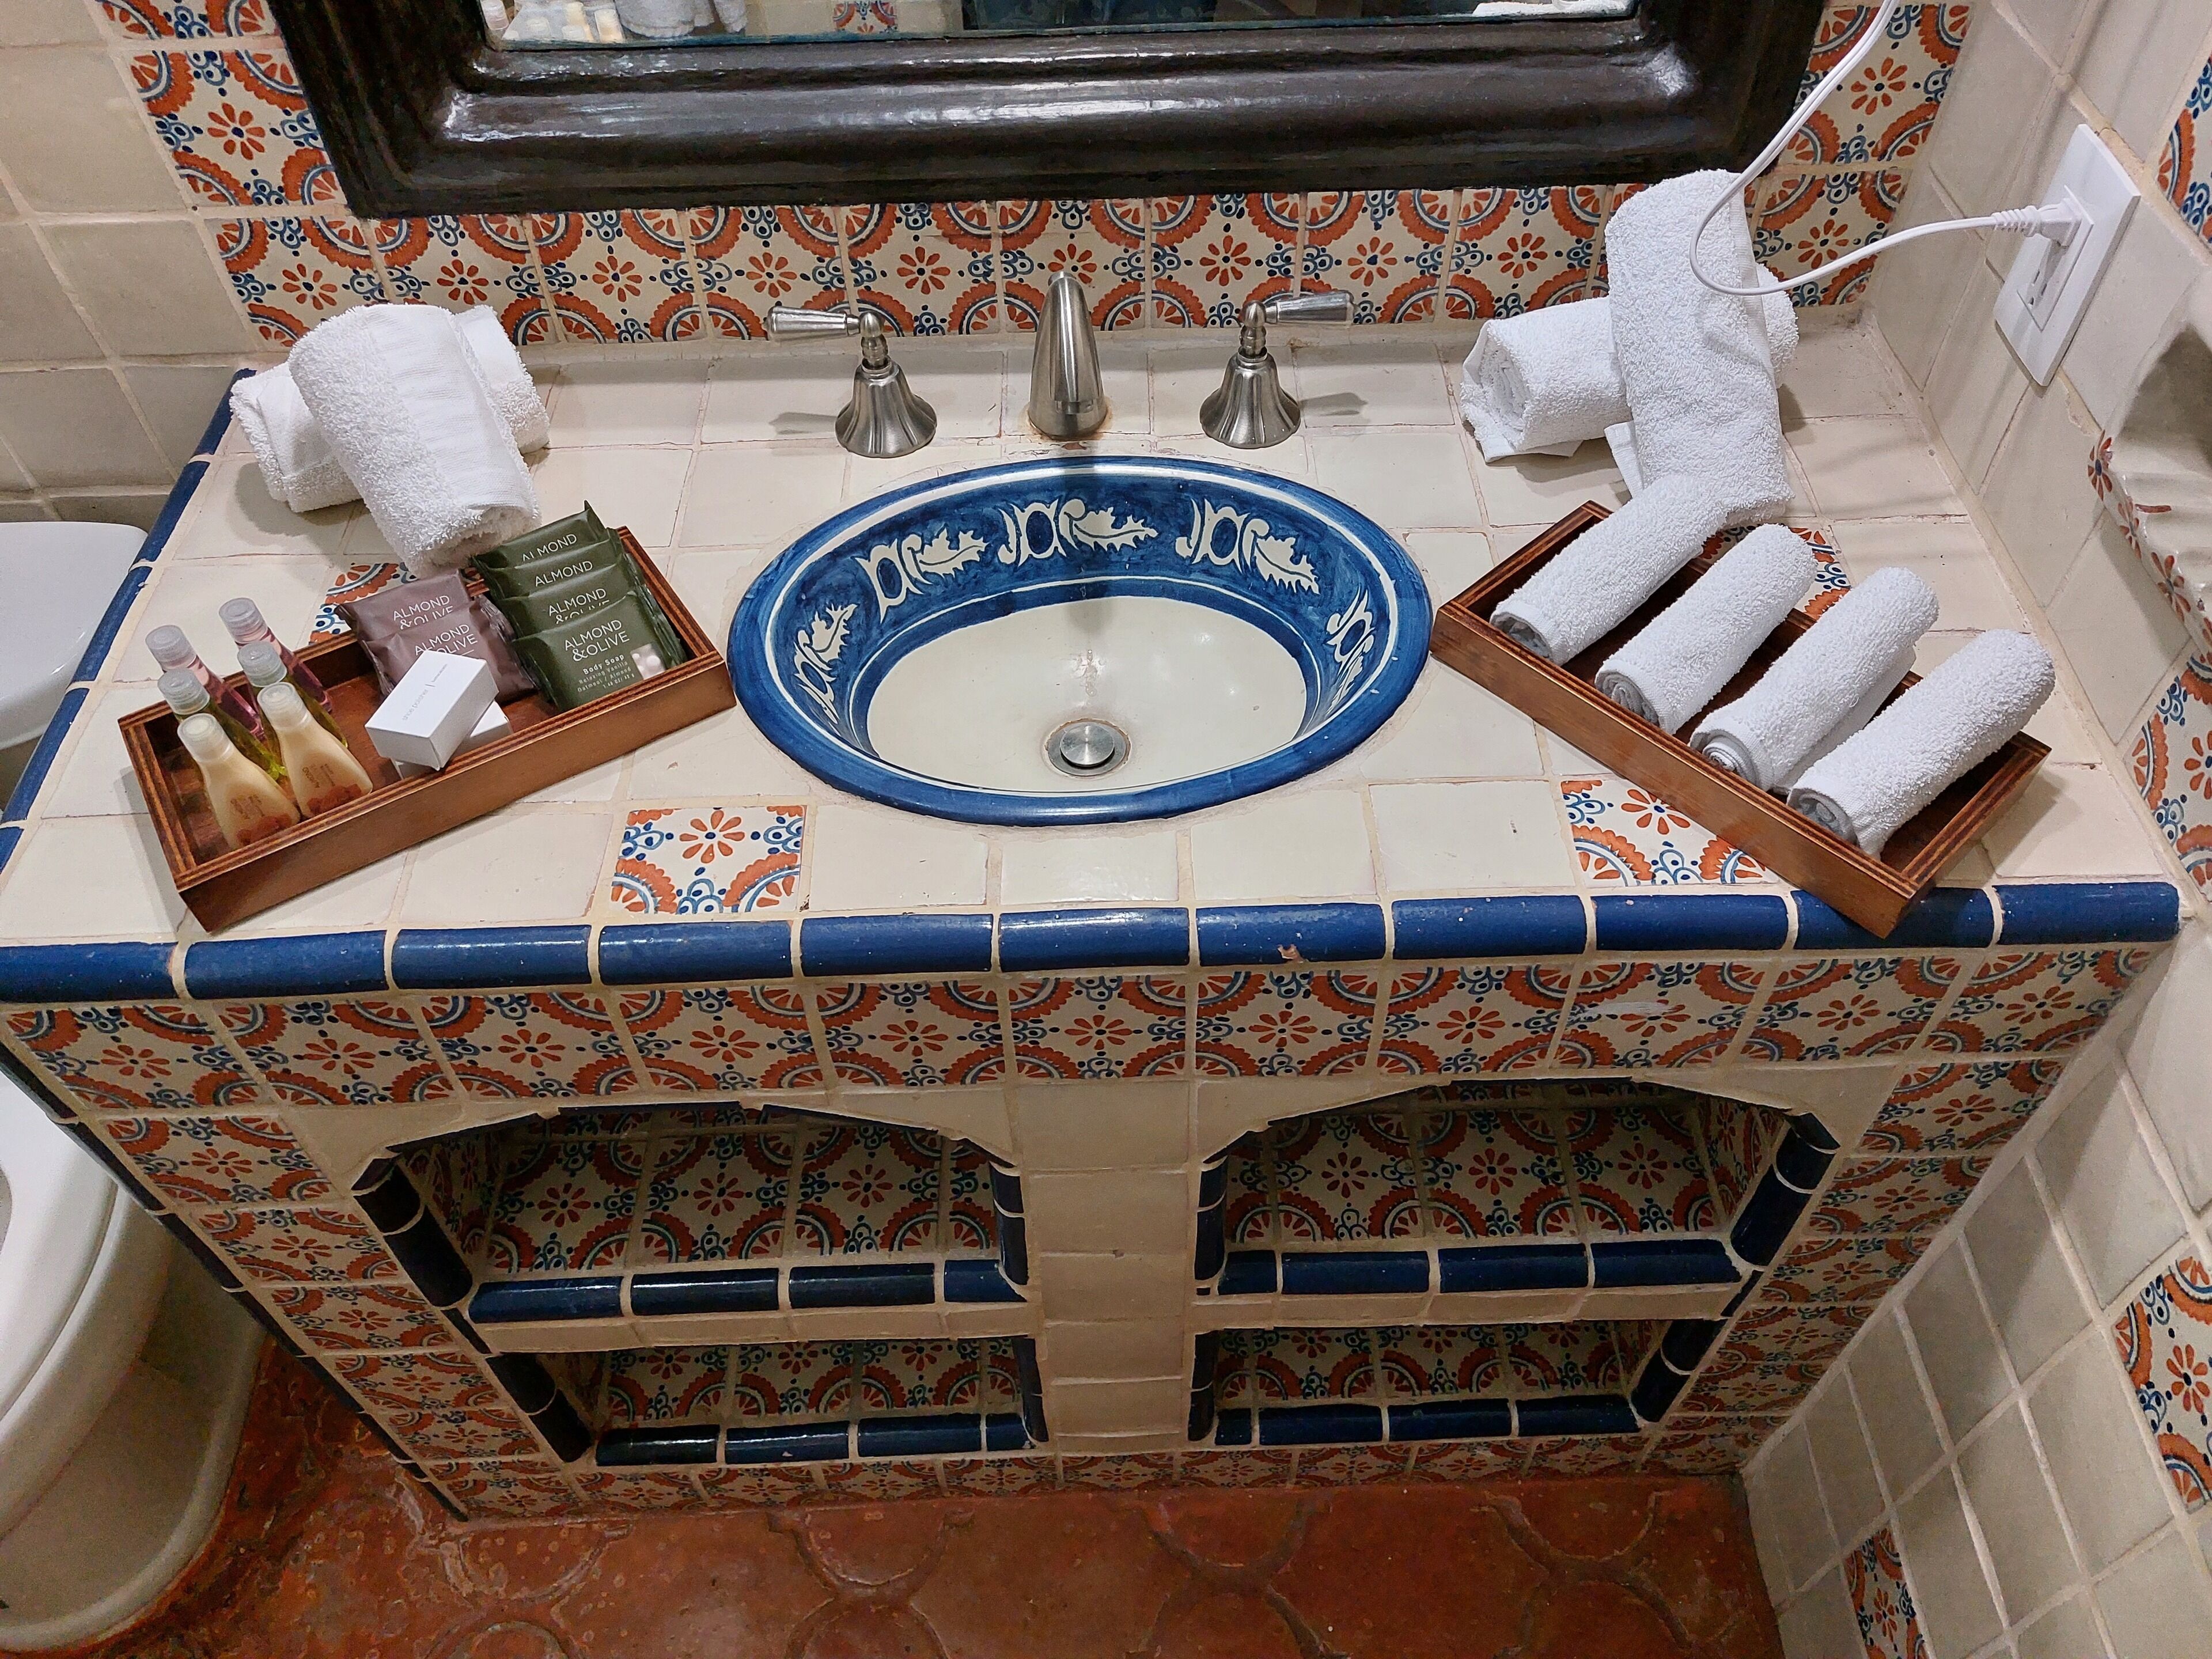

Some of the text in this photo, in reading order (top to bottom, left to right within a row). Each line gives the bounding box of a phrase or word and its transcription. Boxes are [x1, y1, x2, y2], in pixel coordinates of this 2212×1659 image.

[535, 560, 593, 587] ALMOND
[393, 595, 450, 621] ALMOND
[549, 588, 606, 616] ALMOND
[415, 624, 469, 656] ALMOND
[565, 620, 622, 651] ALMOND
[573, 631, 630, 661] &OLIVE
[579, 661, 628, 684] Relaxing Vanilla
[583, 654, 624, 675] Body Soap
[578, 679, 603, 692] Oatmeal
[610, 666, 631, 679] Almond
